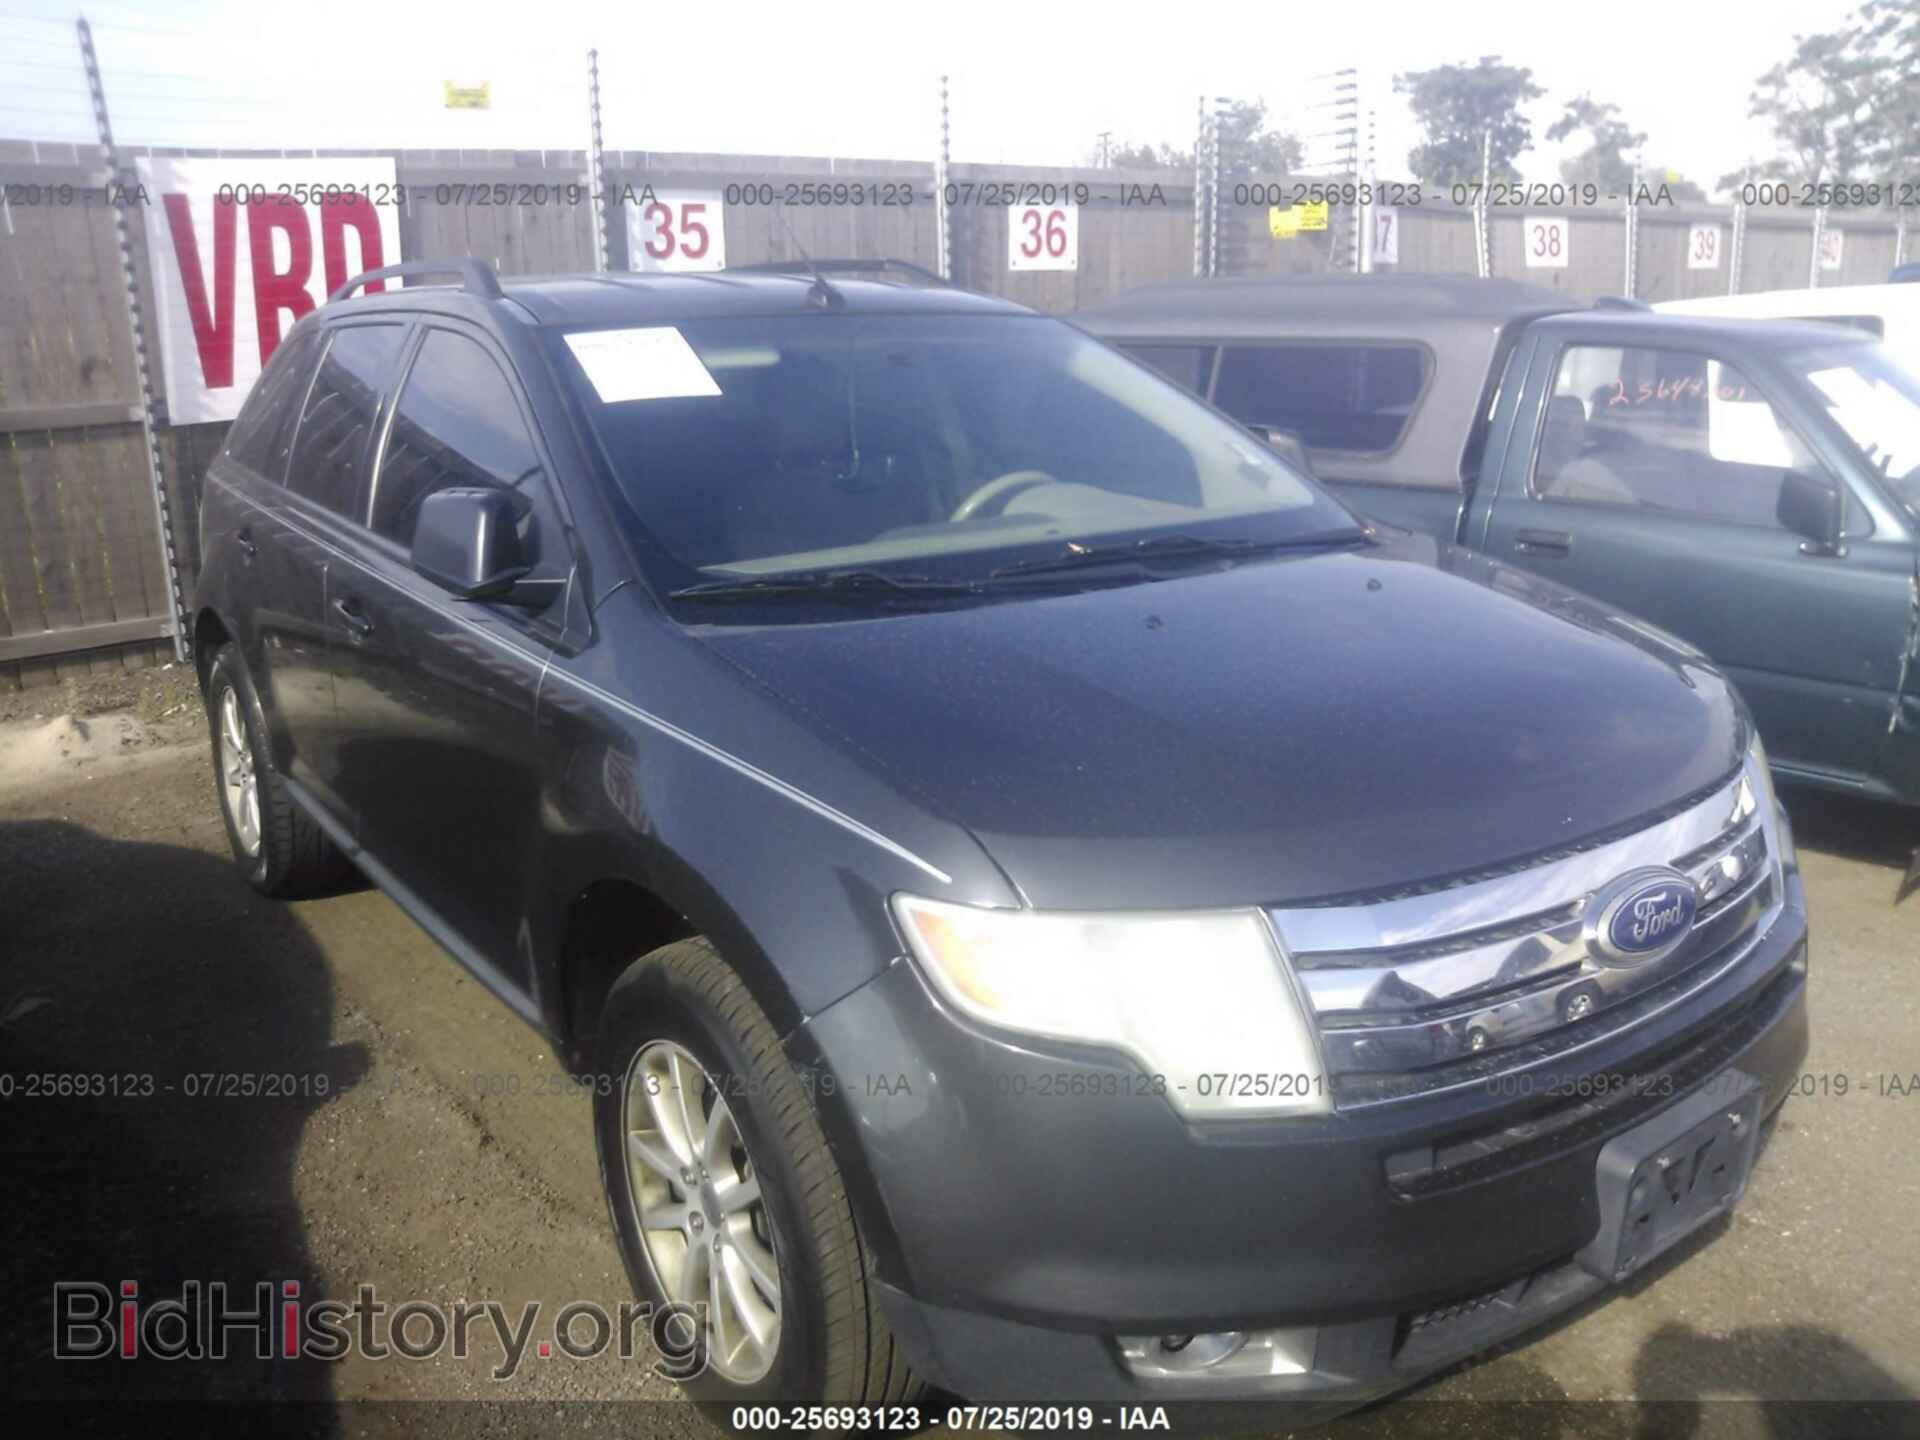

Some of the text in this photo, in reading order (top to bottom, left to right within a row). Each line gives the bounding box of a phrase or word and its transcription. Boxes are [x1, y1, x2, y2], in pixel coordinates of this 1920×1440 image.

[643, 202, 710, 260] 35
[1020, 209, 1068, 259] 36
[1533, 224, 1562, 258] 38
[1694, 230, 1716, 261] 39
[1633, 891, 1684, 942] Ford
